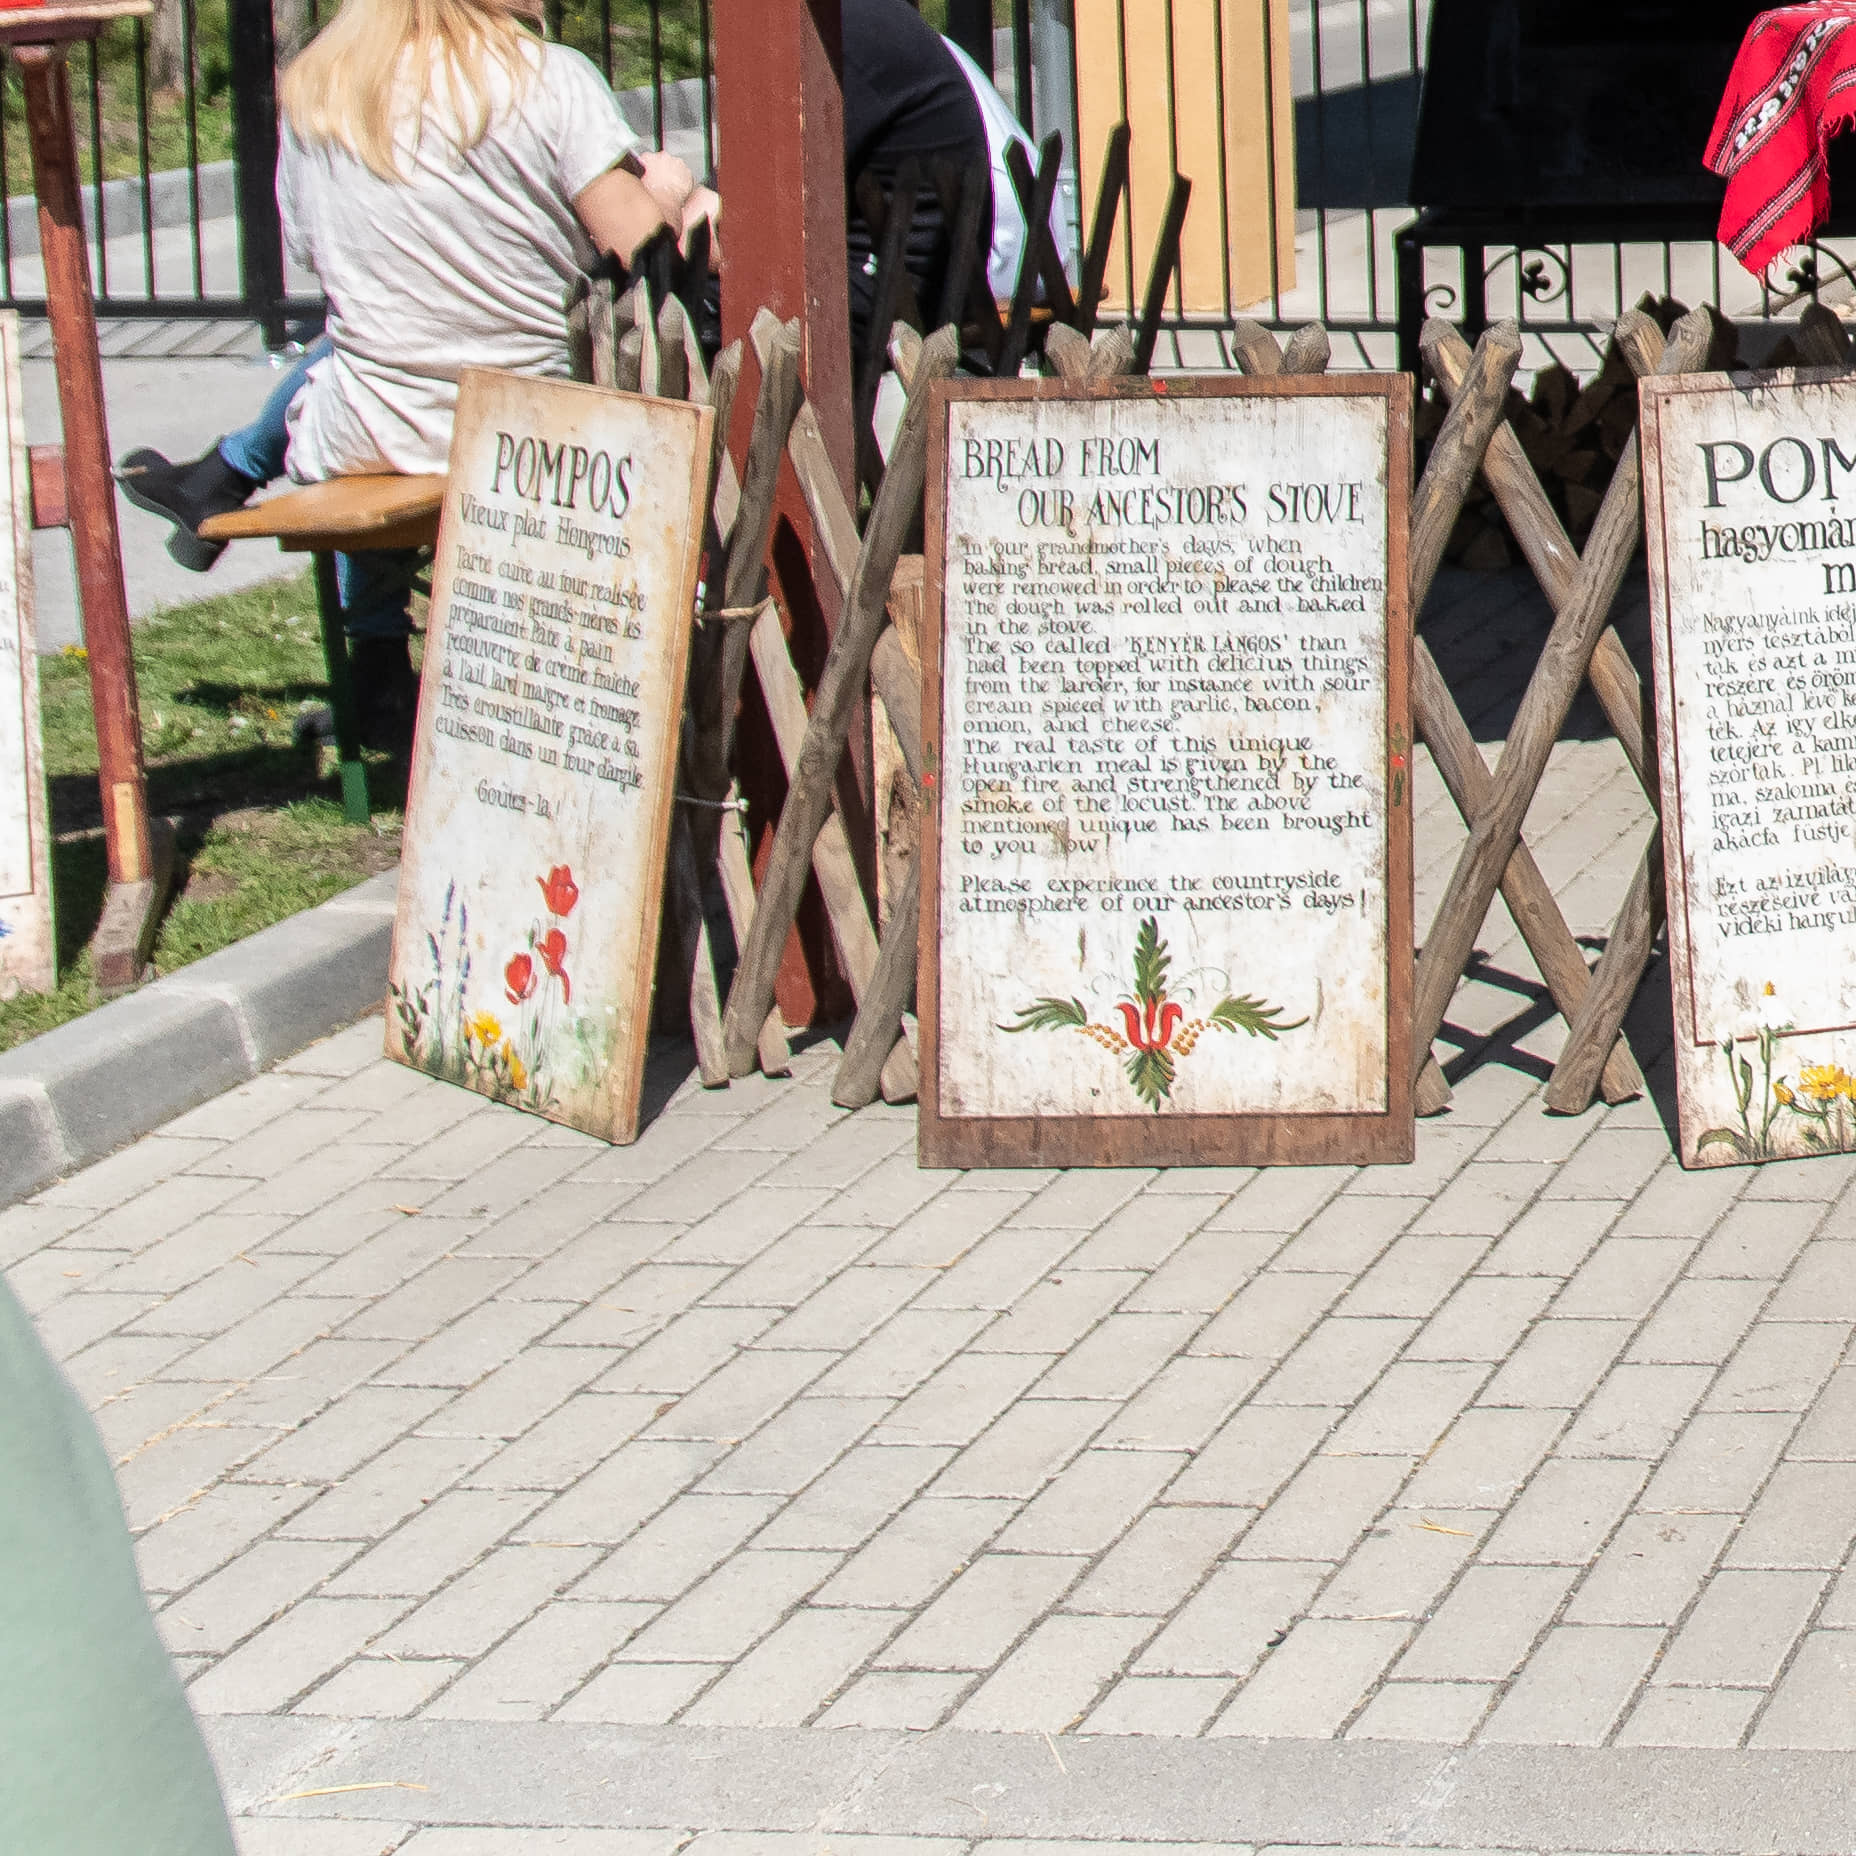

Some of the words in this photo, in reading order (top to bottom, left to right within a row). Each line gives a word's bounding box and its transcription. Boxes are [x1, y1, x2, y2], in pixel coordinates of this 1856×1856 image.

[489, 430, 634, 520] POMPOS
[960, 436, 1064, 493] BREAD
[1079, 436, 1161, 478] FROM
[1018, 487, 1078, 538] OUR
[1086, 482, 1248, 527] ANCESTOR'S
[1266, 481, 1365, 527] STOVE
[460, 492, 510, 532] Vieux
[555, 515, 632, 561] Hongrois
[963, 556, 1031, 580] baking
[1105, 555, 1159, 576] small
[1166, 556, 1225, 583] pieces
[1233, 555, 1254, 574] of
[1263, 554, 1334, 580] dough
[965, 598, 997, 616] The
[1005, 597, 1064, 620] dough
[1075, 599, 1115, 615] was
[1123, 596, 1182, 615] rolled
[1193, 597, 1229, 615] out
[1238, 596, 1281, 614] and
[1297, 594, 1366, 613] baked
[966, 617, 988, 635] in
[998, 617, 1030, 635] the
[966, 655, 1008, 674] had
[1019, 656, 1065, 675] been
[1075, 655, 1141, 680] topped
[1148, 654, 1200, 673] with
[1301, 652, 1370, 678] things
[1772, 651, 1807, 671] azt
[965, 676, 1011, 694] from
[1020, 676, 1050, 694] the
[1135, 676, 1161, 693] for
[1167, 675, 1253, 693] instance
[1262, 674, 1316, 692] with
[1321, 675, 1371, 693] sour
[964, 698, 1033, 715] cream
[1040, 696, 1106, 719] spiced
[1113, 696, 1162, 714] with
[1042, 715, 1089, 734] and
[1095, 754, 1152, 774] meal
[1160, 756, 1179, 774] is
[1185, 756, 1249, 778] given
[1257, 753, 1287, 778] by
[1299, 753, 1339, 772] the
[1755, 781, 1838, 804] szalonna
[1079, 815, 1158, 844] unique
[1171, 813, 1210, 832] has
[1220, 813, 1270, 831] been
[1282, 809, 1374, 836] brought
[960, 873, 1033, 894] Please
[1047, 877, 1160, 902] experience
[1169, 874, 1203, 891] the
[1211, 870, 1342, 895] countryside
[959, 893, 1090, 918] atmosphere
[1100, 892, 1124, 912] of
[1132, 894, 1175, 912] our
